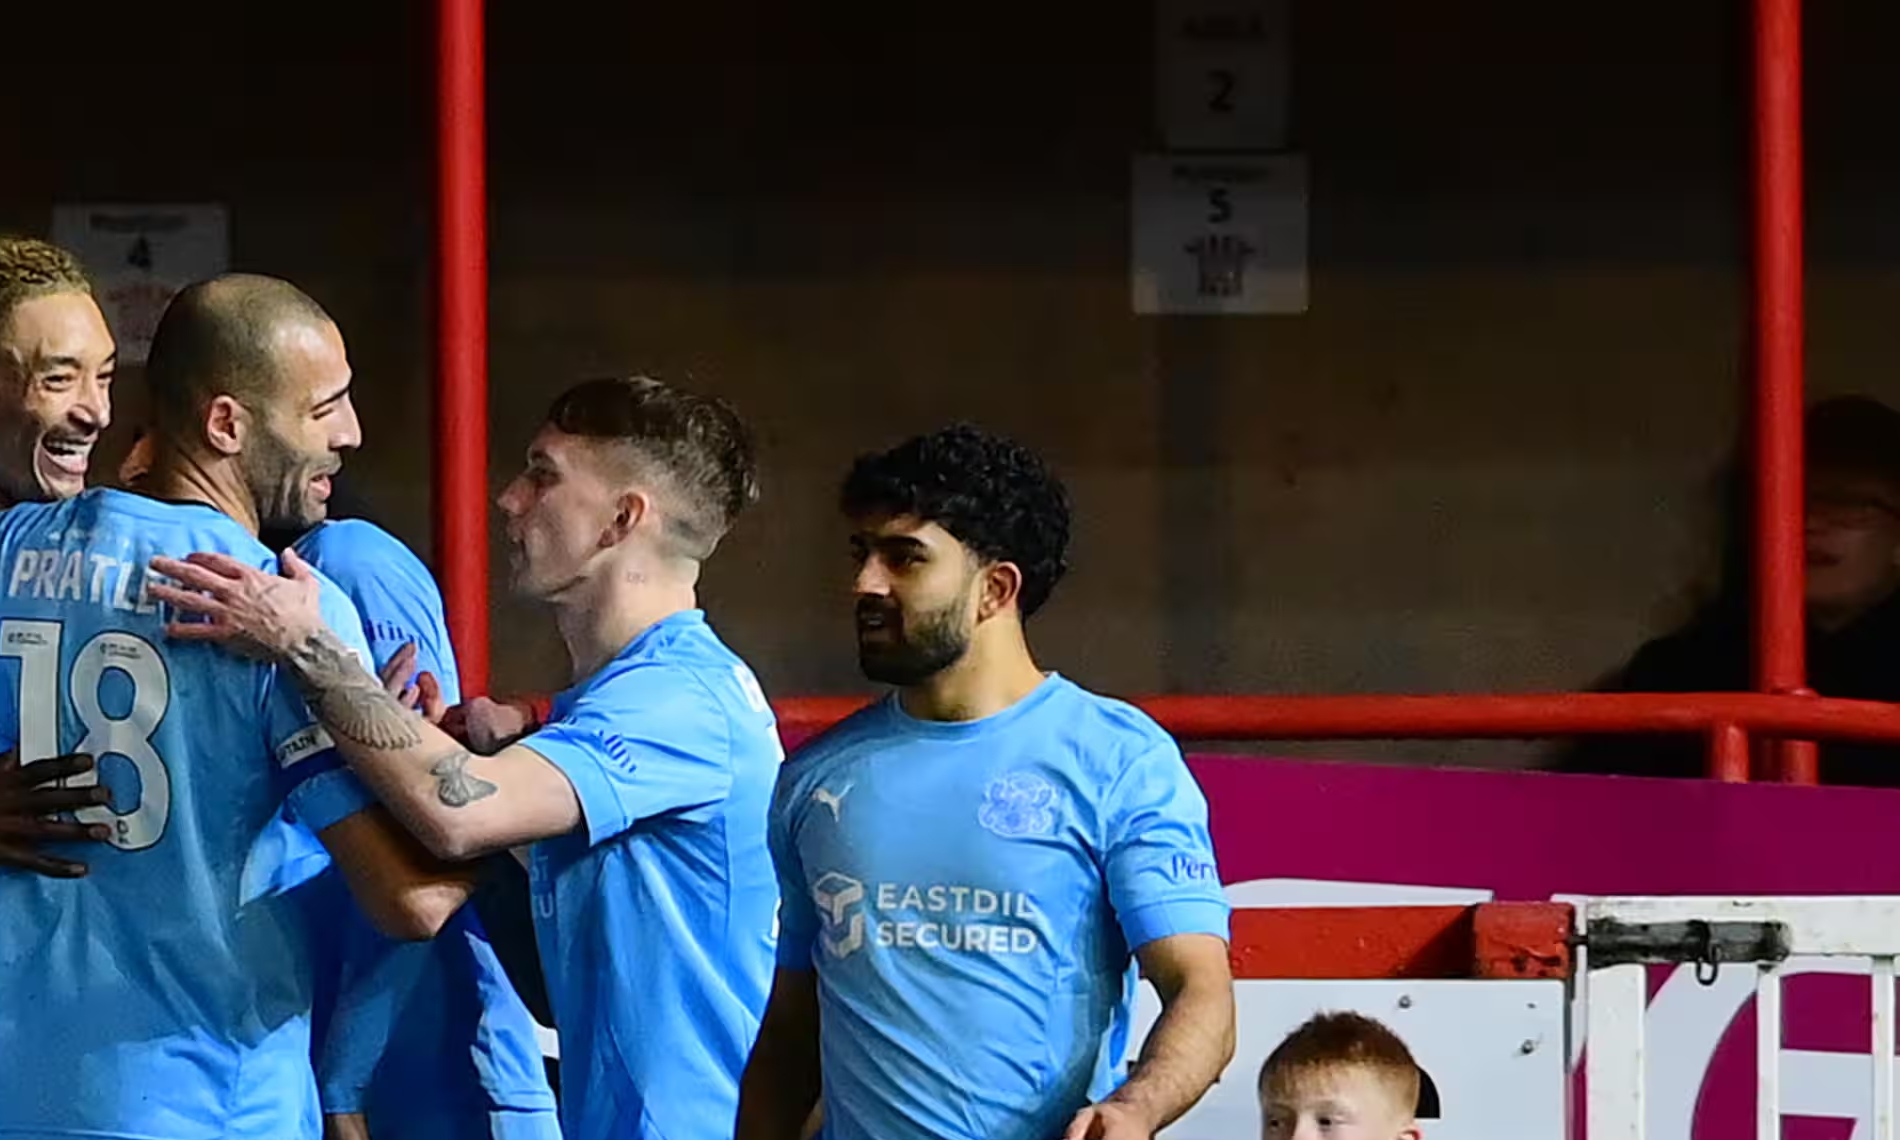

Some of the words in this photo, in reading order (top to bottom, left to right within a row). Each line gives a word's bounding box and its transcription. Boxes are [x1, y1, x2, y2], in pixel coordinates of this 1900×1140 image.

[1206, 67, 1237, 112] 2
[1207, 187, 1233, 223] 5
[8, 549, 180, 615] PRATLE
[0, 619, 169, 850] 18
[877, 883, 1037, 921] EASTDIL
[877, 922, 1037, 955] SECURED
